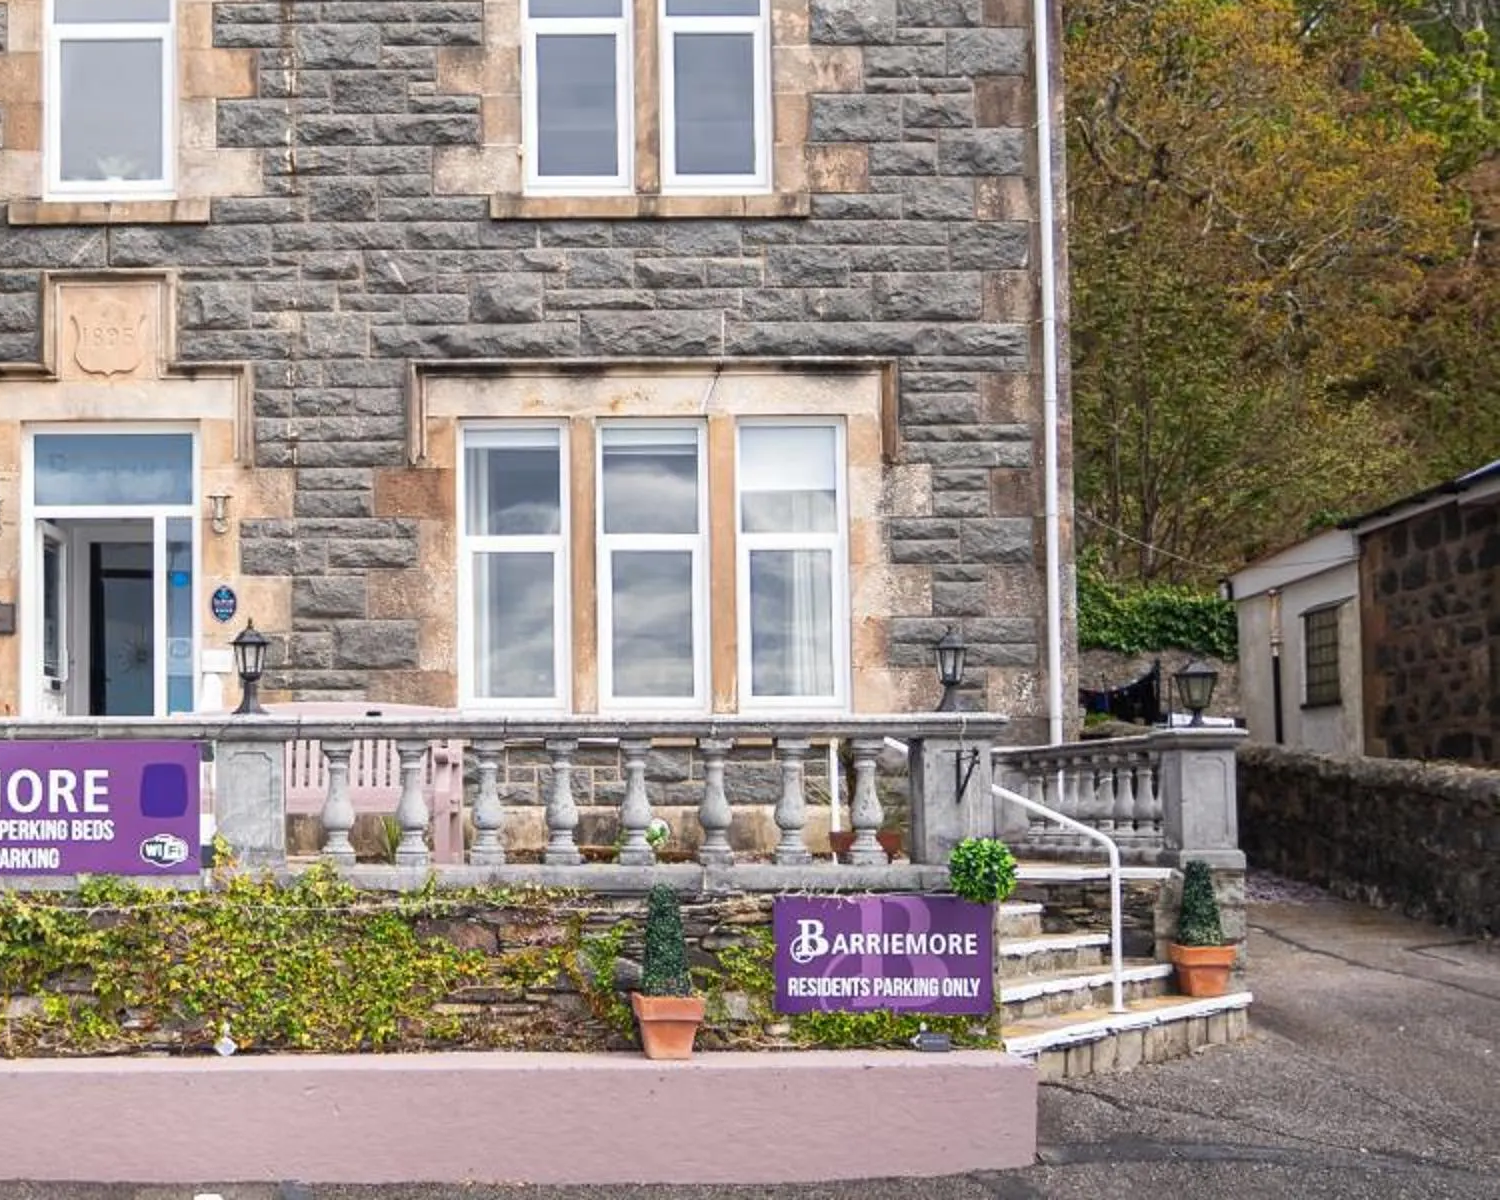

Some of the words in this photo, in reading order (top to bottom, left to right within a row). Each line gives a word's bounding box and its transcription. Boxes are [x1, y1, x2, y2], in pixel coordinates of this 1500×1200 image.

[71, 819, 115, 841] BEDS
[790, 919, 978, 963] BARRIEMORE
[788, 977, 870, 997] RESIDENTS
[873, 977, 938, 997] PARKING
[942, 977, 981, 997] ONLY
